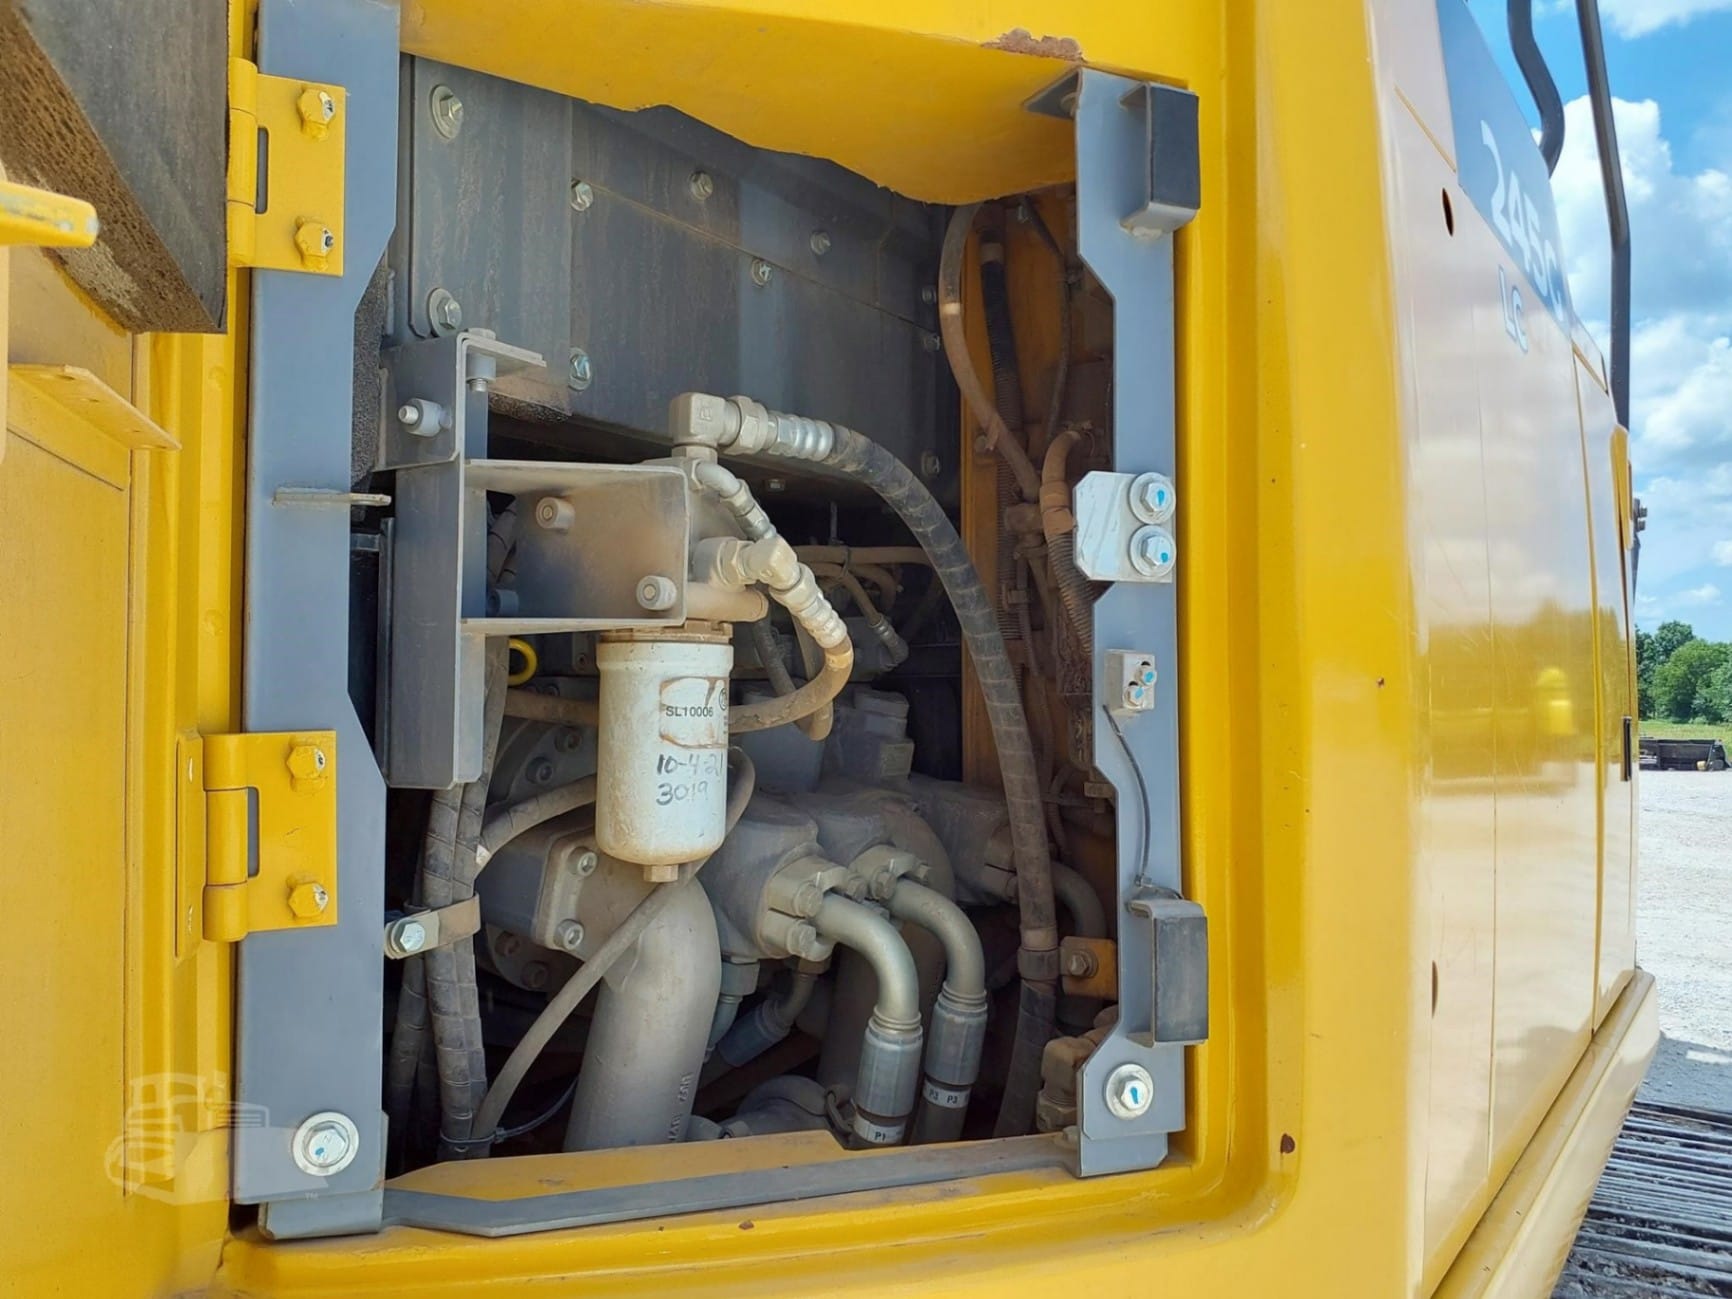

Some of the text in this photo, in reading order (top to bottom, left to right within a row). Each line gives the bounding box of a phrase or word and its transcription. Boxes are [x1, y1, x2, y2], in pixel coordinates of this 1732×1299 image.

[665, 705, 714, 718] SL10006
[946, 1094, 959, 1105] P3
[874, 1130, 886, 1142] P1
